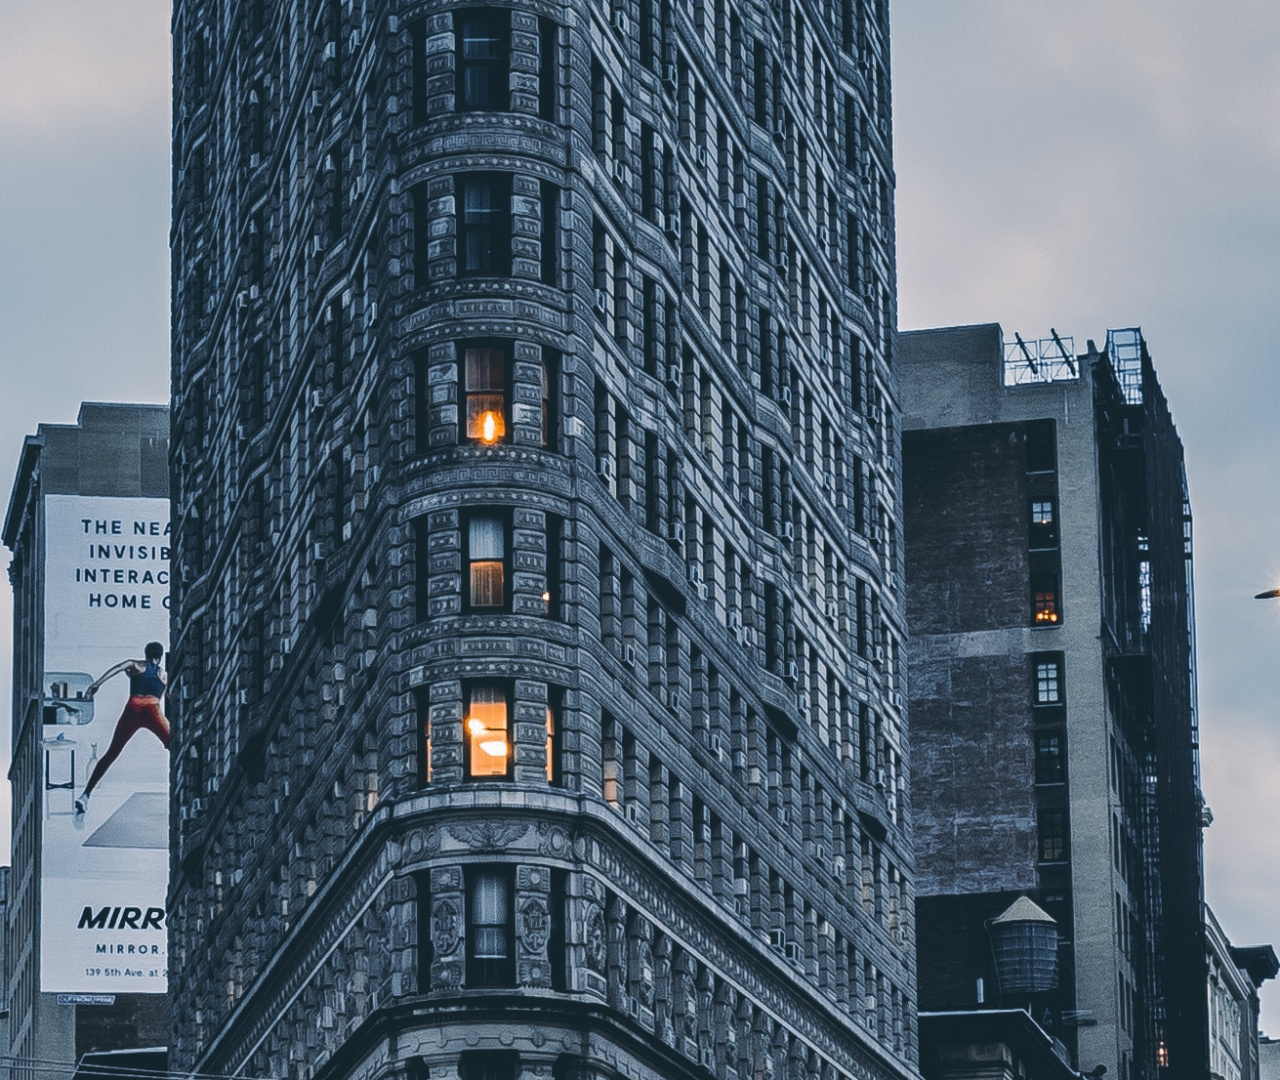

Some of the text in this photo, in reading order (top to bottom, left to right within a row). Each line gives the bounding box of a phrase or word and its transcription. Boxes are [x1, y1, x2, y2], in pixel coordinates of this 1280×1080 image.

[81, 519, 122, 535] THE
[90, 544, 170, 560] INVISIB
[76, 568, 169, 585] INTERAC
[89, 593, 151, 609] HOME
[77, 906, 165, 930] MIRR
[96, 944, 165, 954] MIRROR.
[125, 969, 145, 977] Ave.
[149, 969, 158, 977] at
